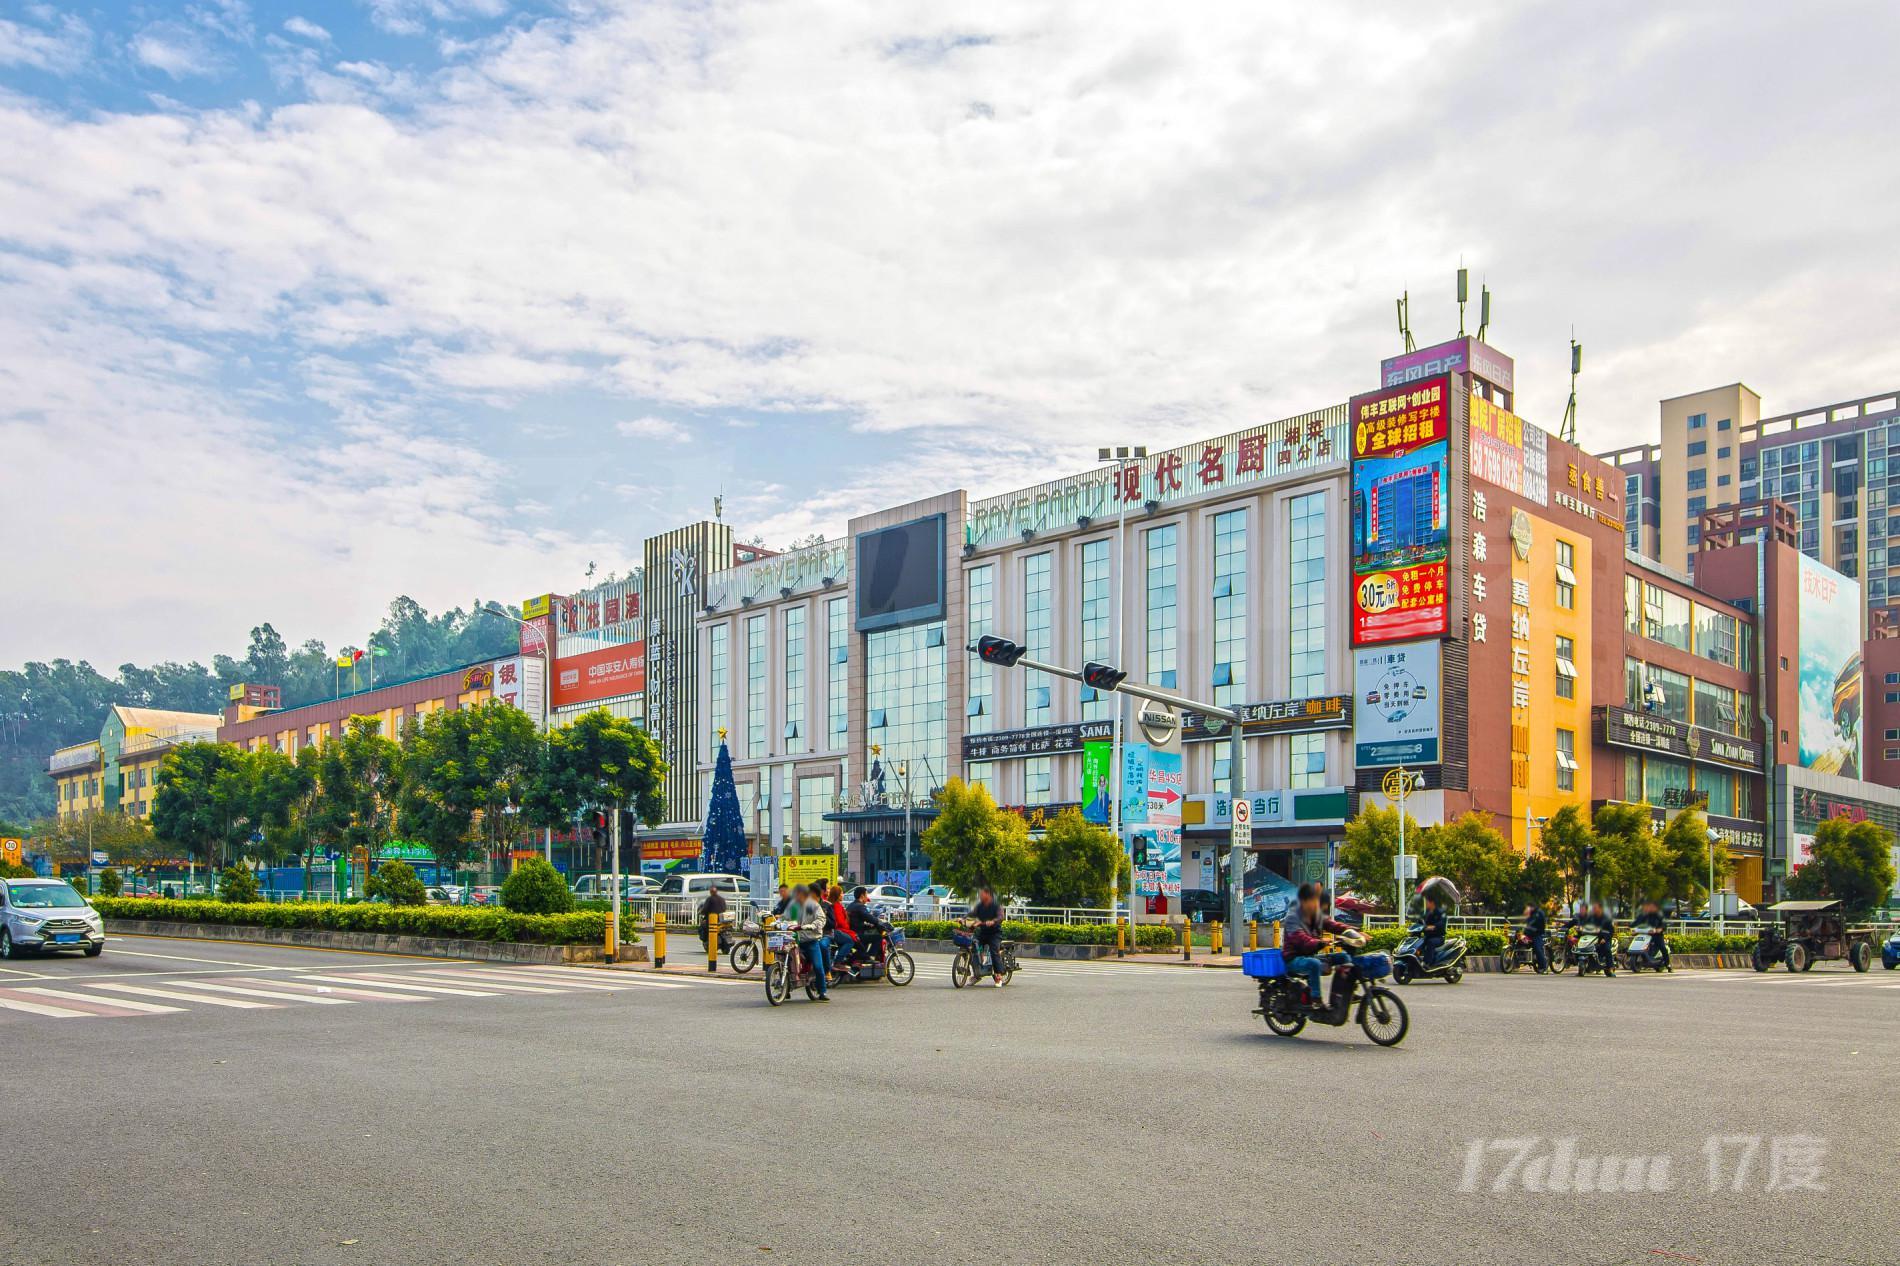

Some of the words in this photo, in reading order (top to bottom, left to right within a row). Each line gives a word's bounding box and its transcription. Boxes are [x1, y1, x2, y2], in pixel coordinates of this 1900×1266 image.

[1284, 420, 1324, 446] 湘菜
[1371, 419, 1434, 451] 全球招租
[1277, 438, 1331, 467] 四分店
[1113, 433, 1267, 504] 现代名厨
[1036, 475, 1110, 520] PARTY
[1402, 566, 1443, 582] 免租一个月
[1472, 490, 1487, 644] 浩森车贷
[1402, 579, 1444, 596] 免费停车
[1306, 697, 1342, 714] 咖啡
[1143, 714, 1176, 725] NISSAN
[1080, 725, 1111, 738] SANA
[1216, 797, 1280, 817] 浩当行
